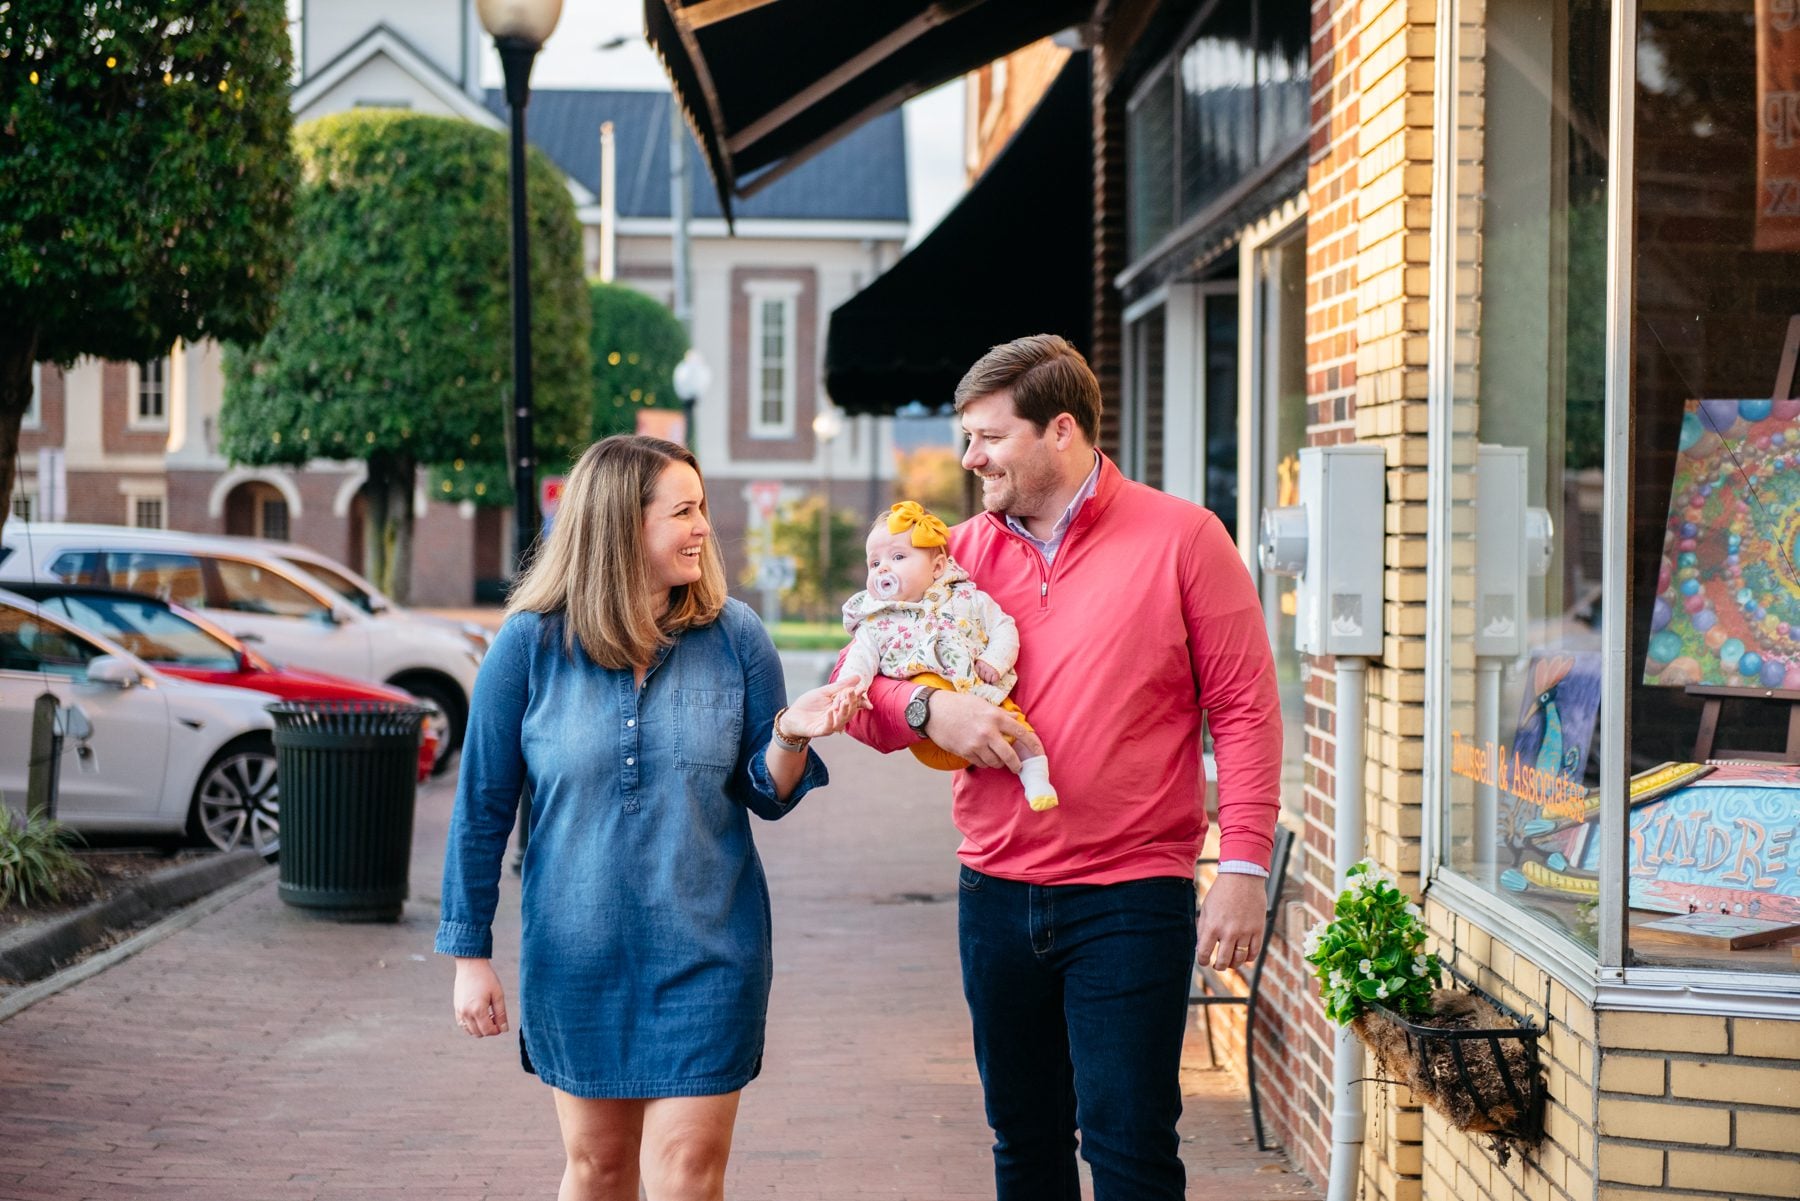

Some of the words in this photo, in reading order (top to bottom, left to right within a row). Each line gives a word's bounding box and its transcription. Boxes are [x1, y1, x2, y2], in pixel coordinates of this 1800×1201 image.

[1498, 744, 1508, 792] &
[1511, 751, 1585, 823] Associates
[1630, 802, 1800, 889] KINDRE
